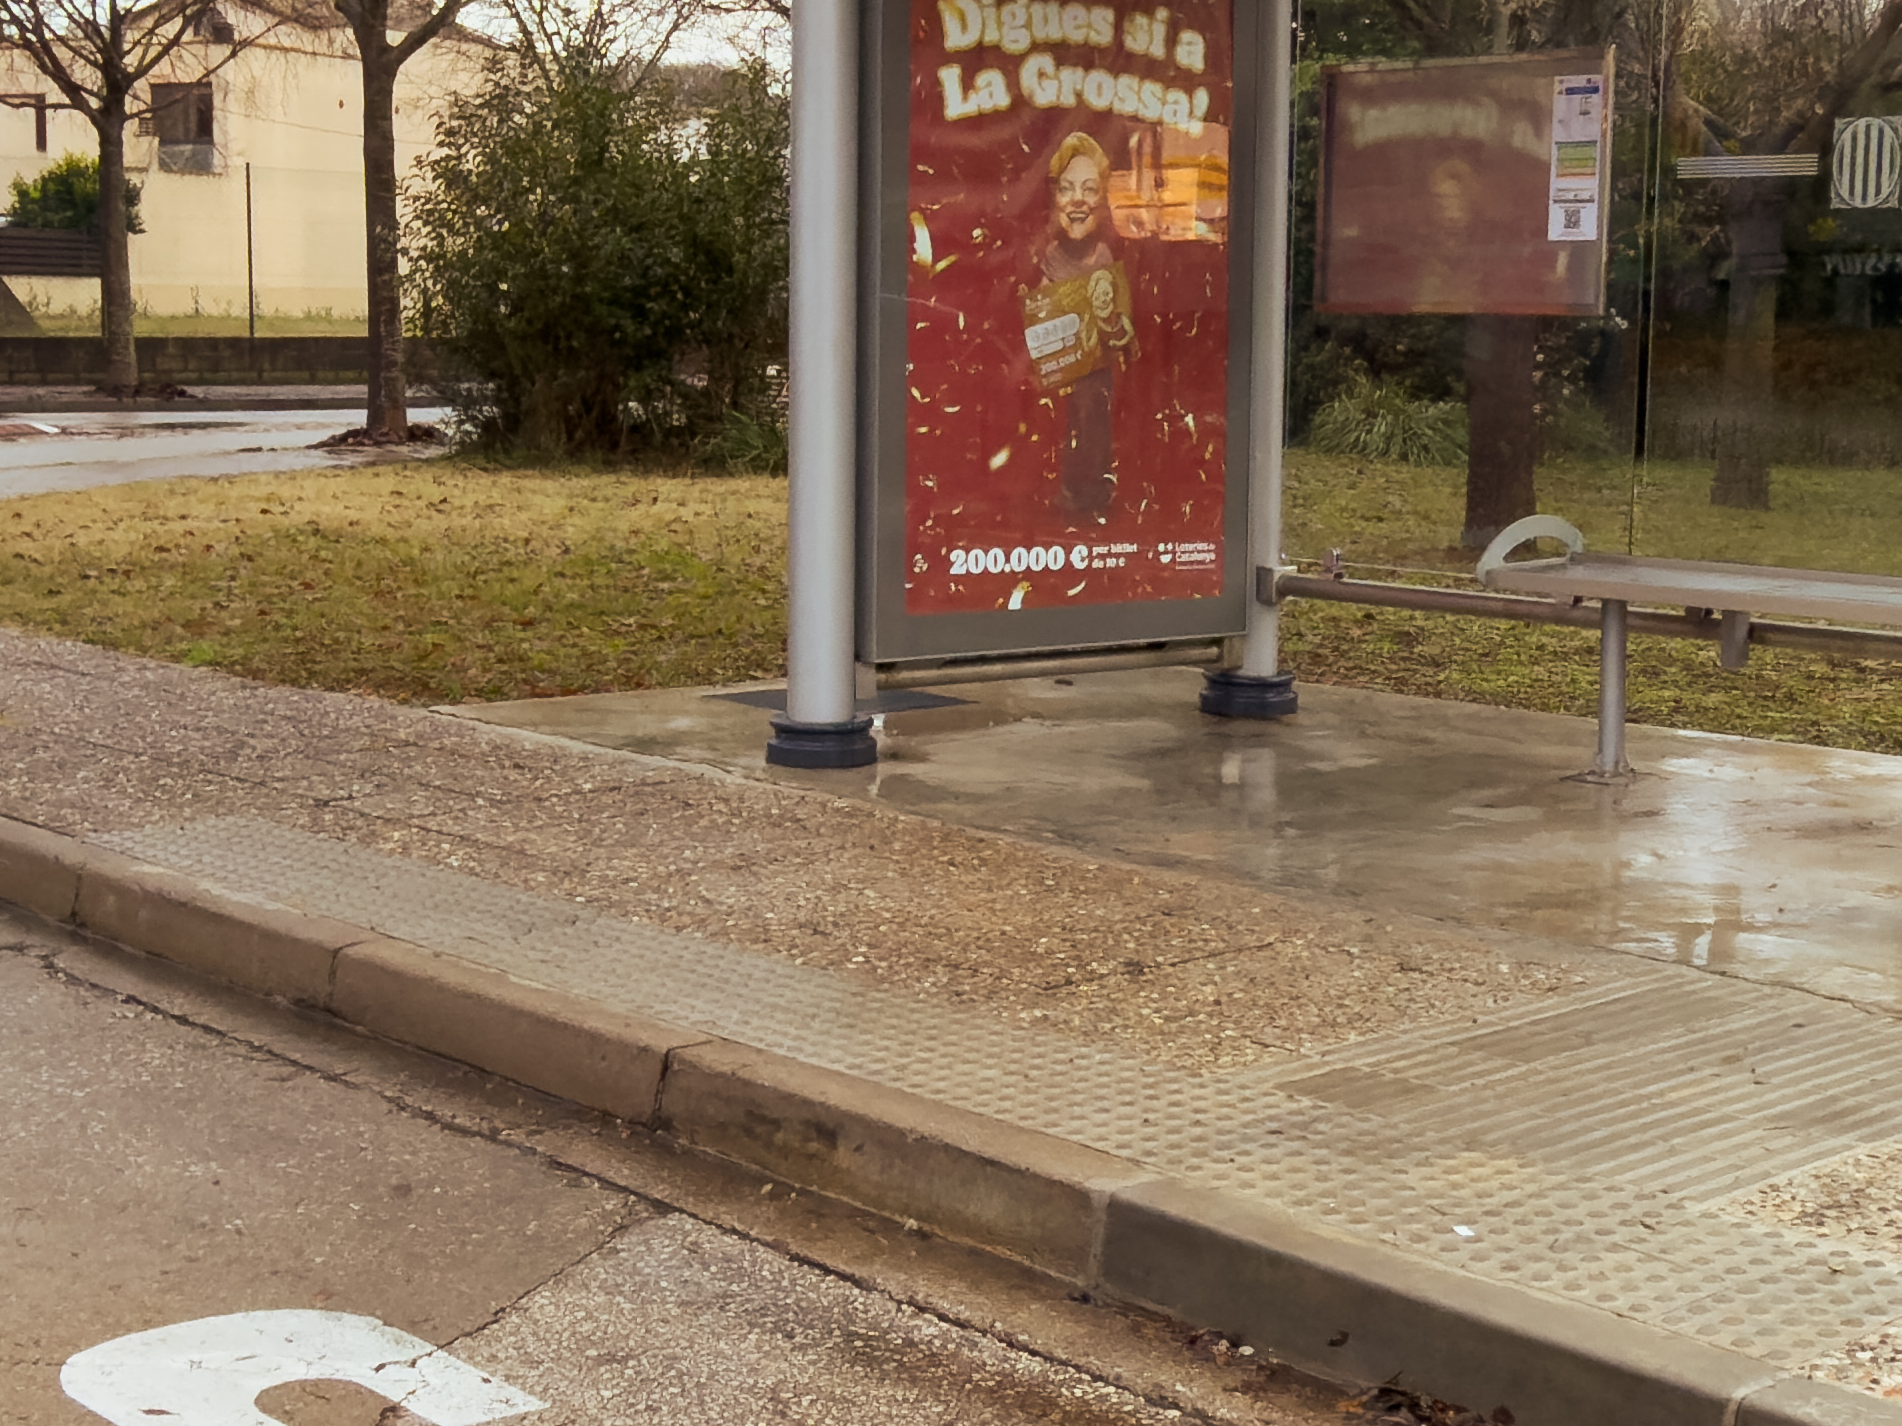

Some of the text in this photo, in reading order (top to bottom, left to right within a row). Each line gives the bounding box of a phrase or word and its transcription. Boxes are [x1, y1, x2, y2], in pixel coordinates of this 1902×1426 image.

[1174, 28, 1206, 74] a
[937, 51, 1211, 139] La Grossa!
[949, 544, 1089, 575] 200.000 €
